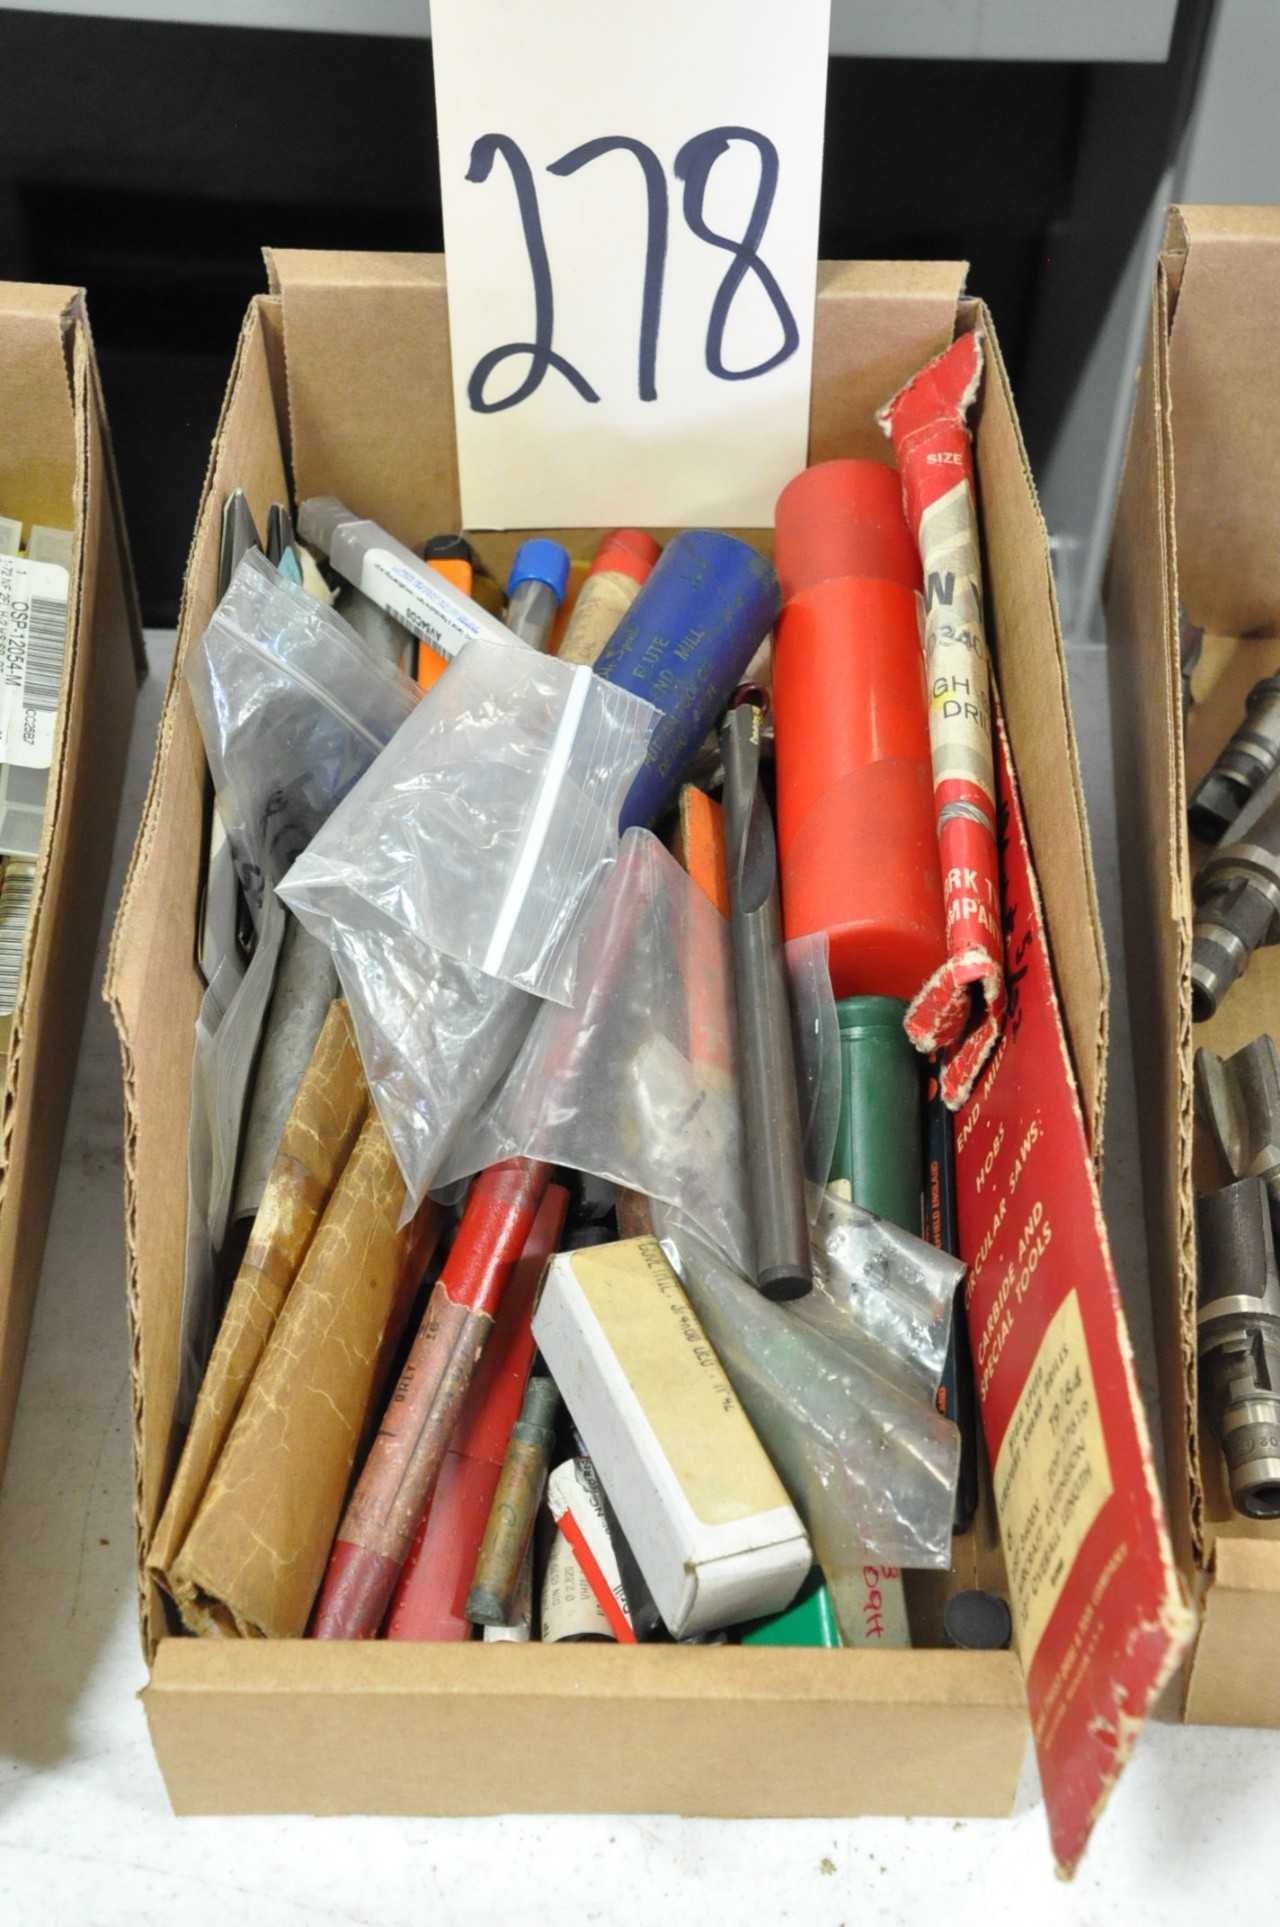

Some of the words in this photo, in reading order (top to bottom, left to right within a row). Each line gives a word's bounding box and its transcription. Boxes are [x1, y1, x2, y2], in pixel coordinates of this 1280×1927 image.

[465, 126, 800, 413] 278
[926, 451, 963, 466] SIZE
[5, 601, 29, 687] OSP-12054-M
[957, 1103, 980, 1153] END
[976, 1121, 1004, 1193] HOBS
[965, 1198, 1006, 1310] CIRCULAR
[978, 1261, 1016, 1366] CARBIDE
[1018, 1201, 1043, 1264] AND
[980, 1309, 1014, 1403] SPECIAL
[1015, 1220, 1052, 1304] TOOLS
